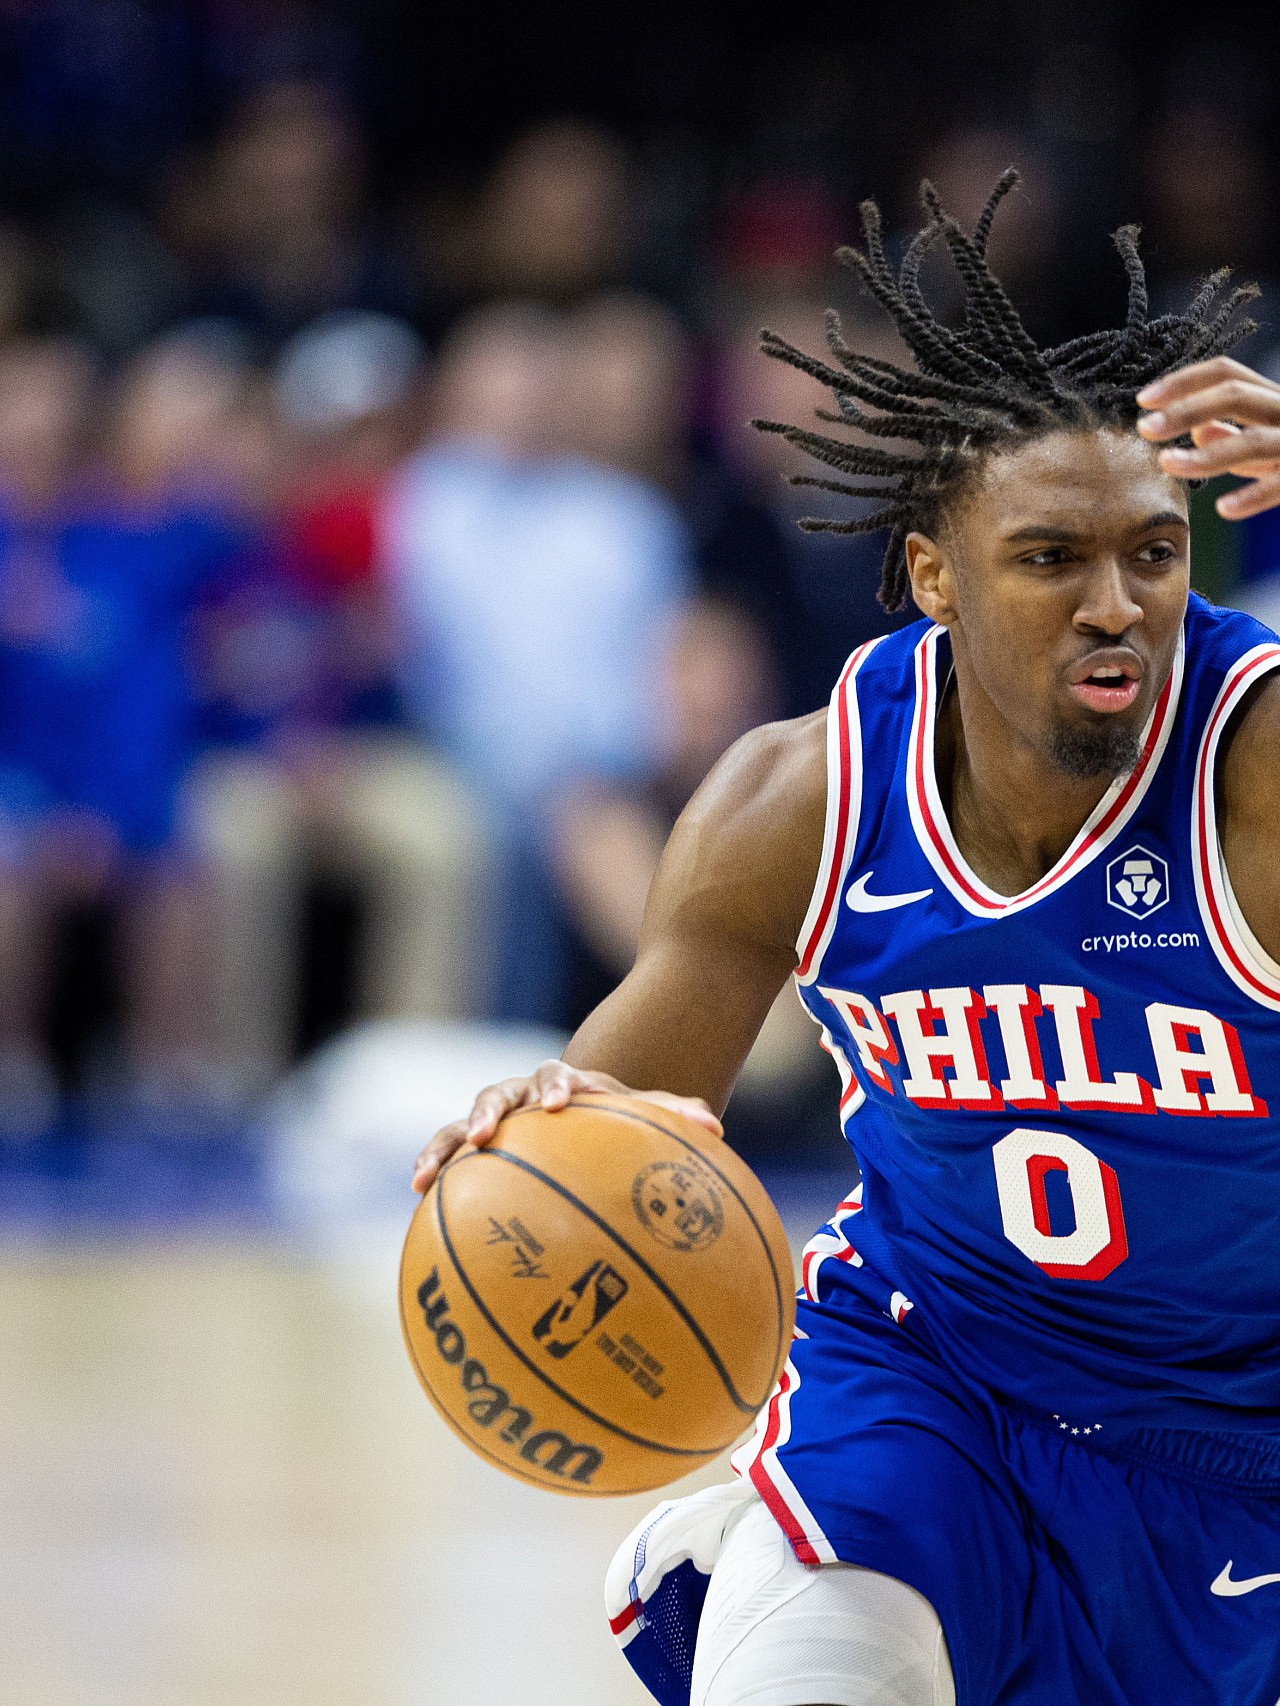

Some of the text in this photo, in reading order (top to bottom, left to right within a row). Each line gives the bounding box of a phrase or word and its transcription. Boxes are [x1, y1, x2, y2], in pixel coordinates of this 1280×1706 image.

[1081, 931, 1200, 953] crypto.com
[816, 983, 1269, 1118] PHILA
[992, 1127, 1128, 1281] 0
[416, 1264, 604, 1485] Wilson
